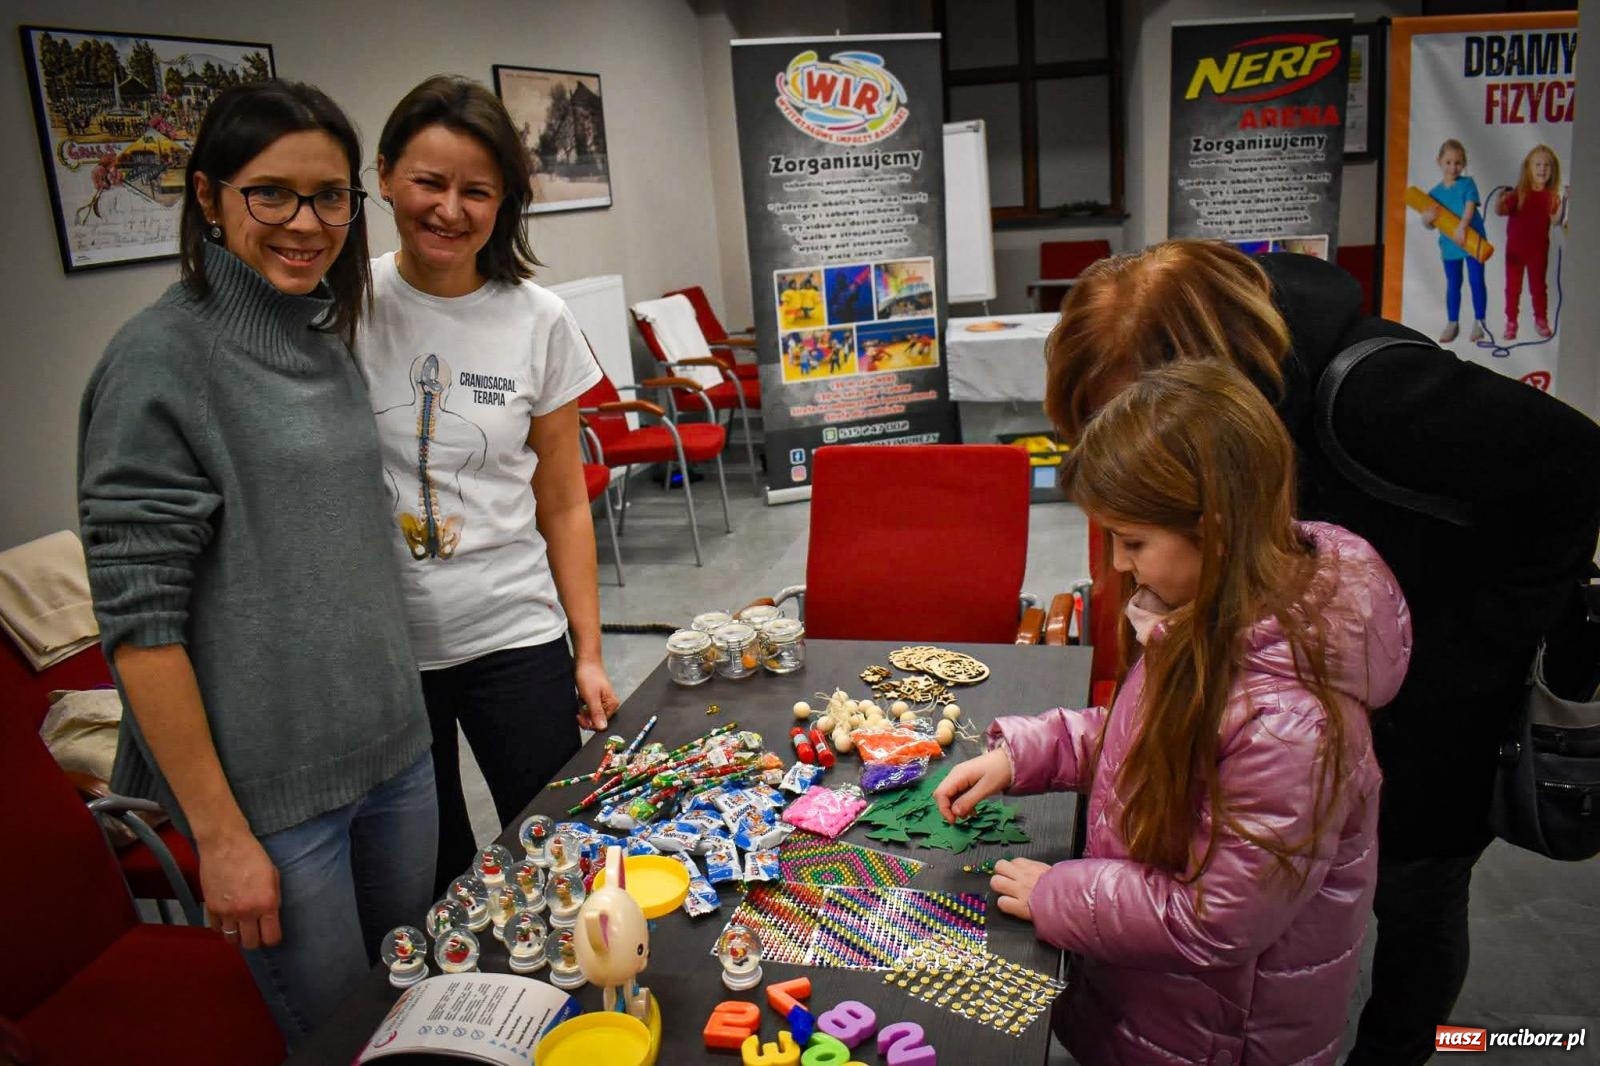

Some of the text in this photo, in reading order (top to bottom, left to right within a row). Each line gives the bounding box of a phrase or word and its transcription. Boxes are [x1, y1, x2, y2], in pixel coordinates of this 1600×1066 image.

[1464, 32, 1577, 77] DBAMY
[1185, 39, 1339, 99] NERF
[806, 71, 879, 115] WIR
[1239, 104, 1341, 129] ARENA
[1192, 134, 1326, 154] Zorganizujemy
[770, 150, 921, 175] Zorganizujemy
[460, 371, 517, 393] CRANIOSACRAL
[473, 390, 506, 406] TERAPIA
